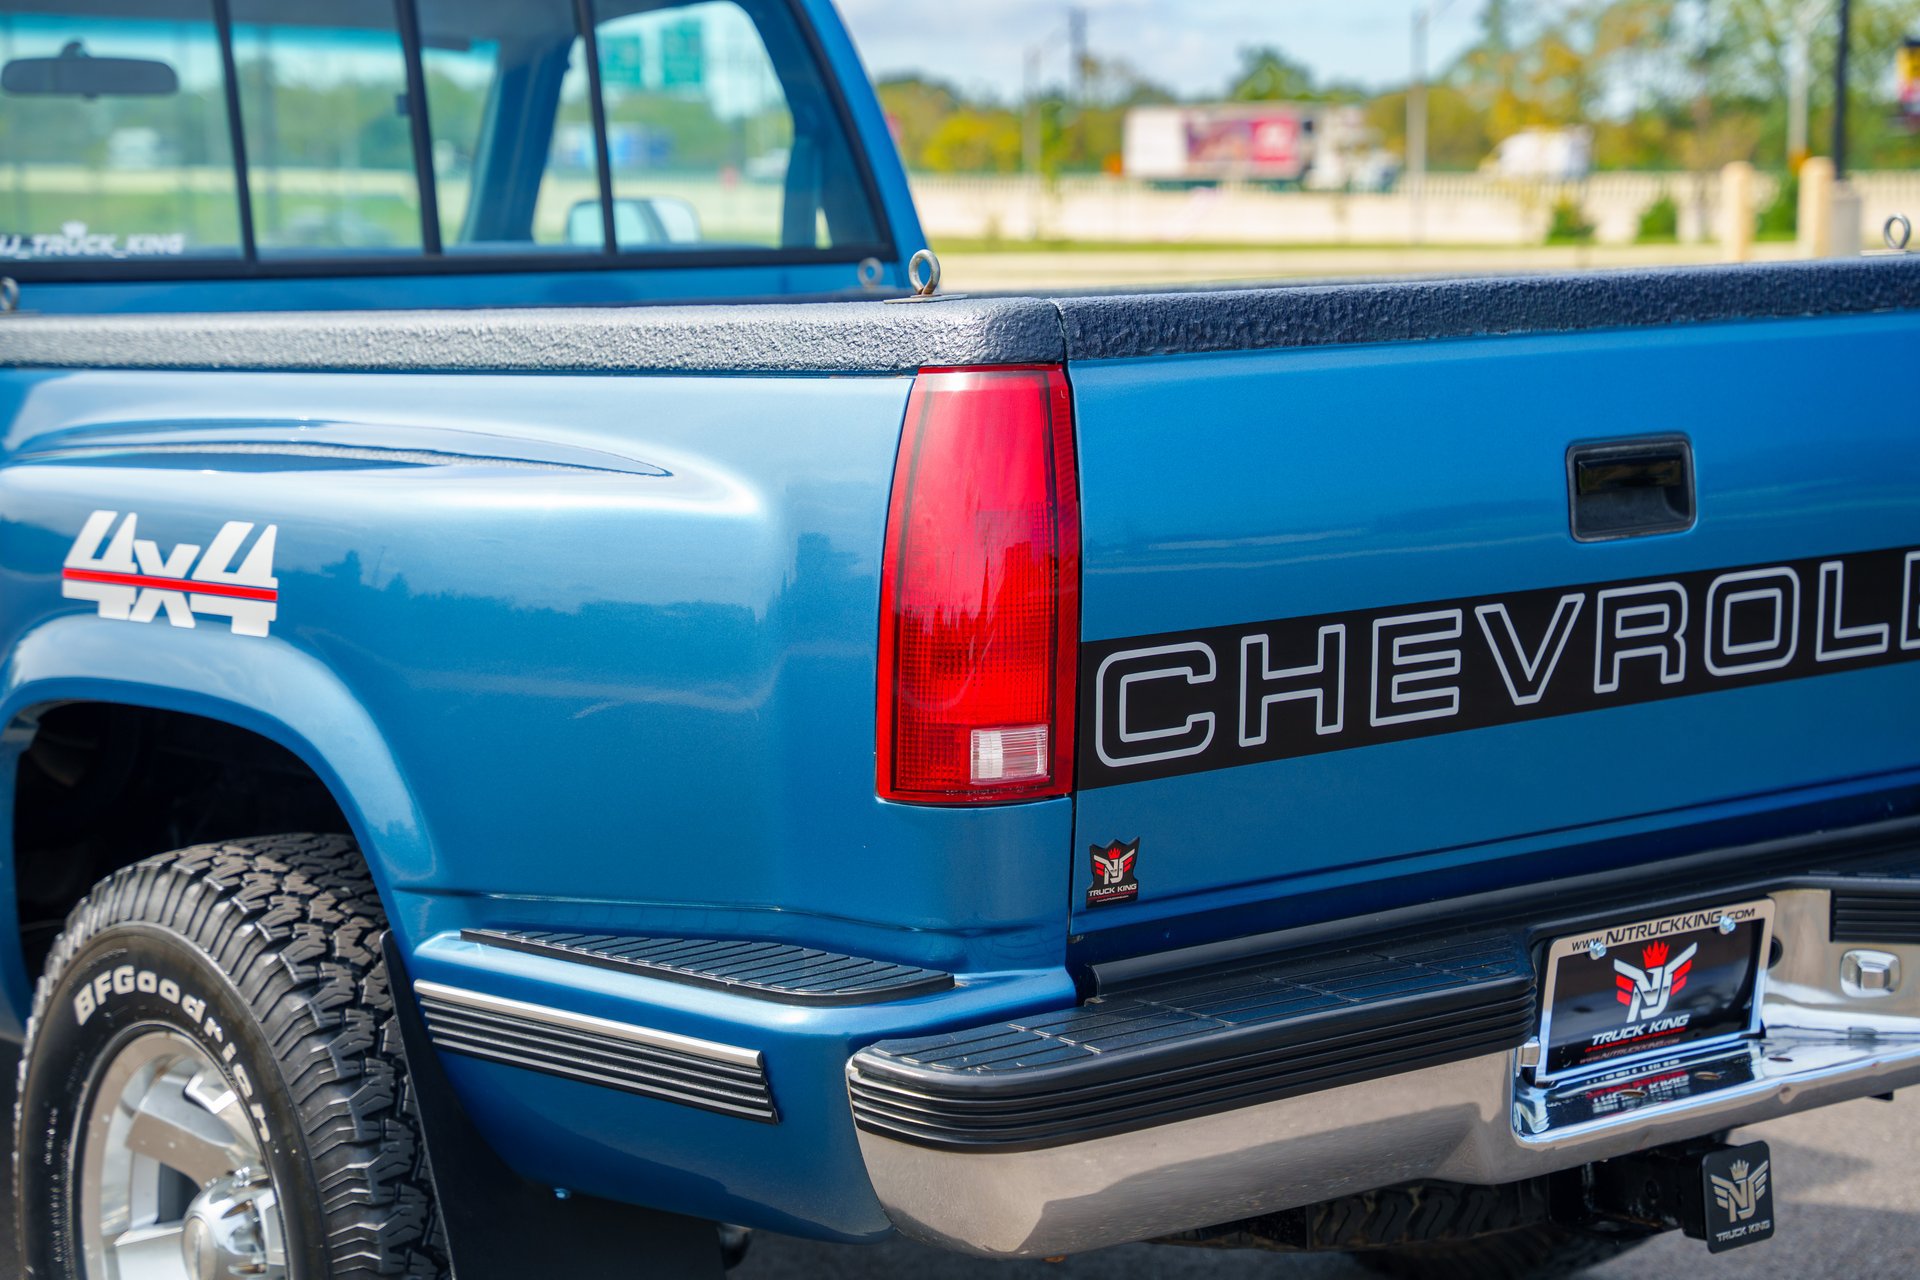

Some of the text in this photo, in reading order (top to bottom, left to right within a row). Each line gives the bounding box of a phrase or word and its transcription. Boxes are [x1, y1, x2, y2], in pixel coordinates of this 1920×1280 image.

[1095, 550, 1920, 768] CHEVROL
[1088, 883, 1137, 897] TRUCK KING
[1571, 907, 1755, 952] WWWNJTRUCKKINGCOM
[1592, 1023, 1646, 1046] TRUCK
[1648, 1013, 1690, 1034] KING
[1716, 1219, 1770, 1242] TRUCK KING
